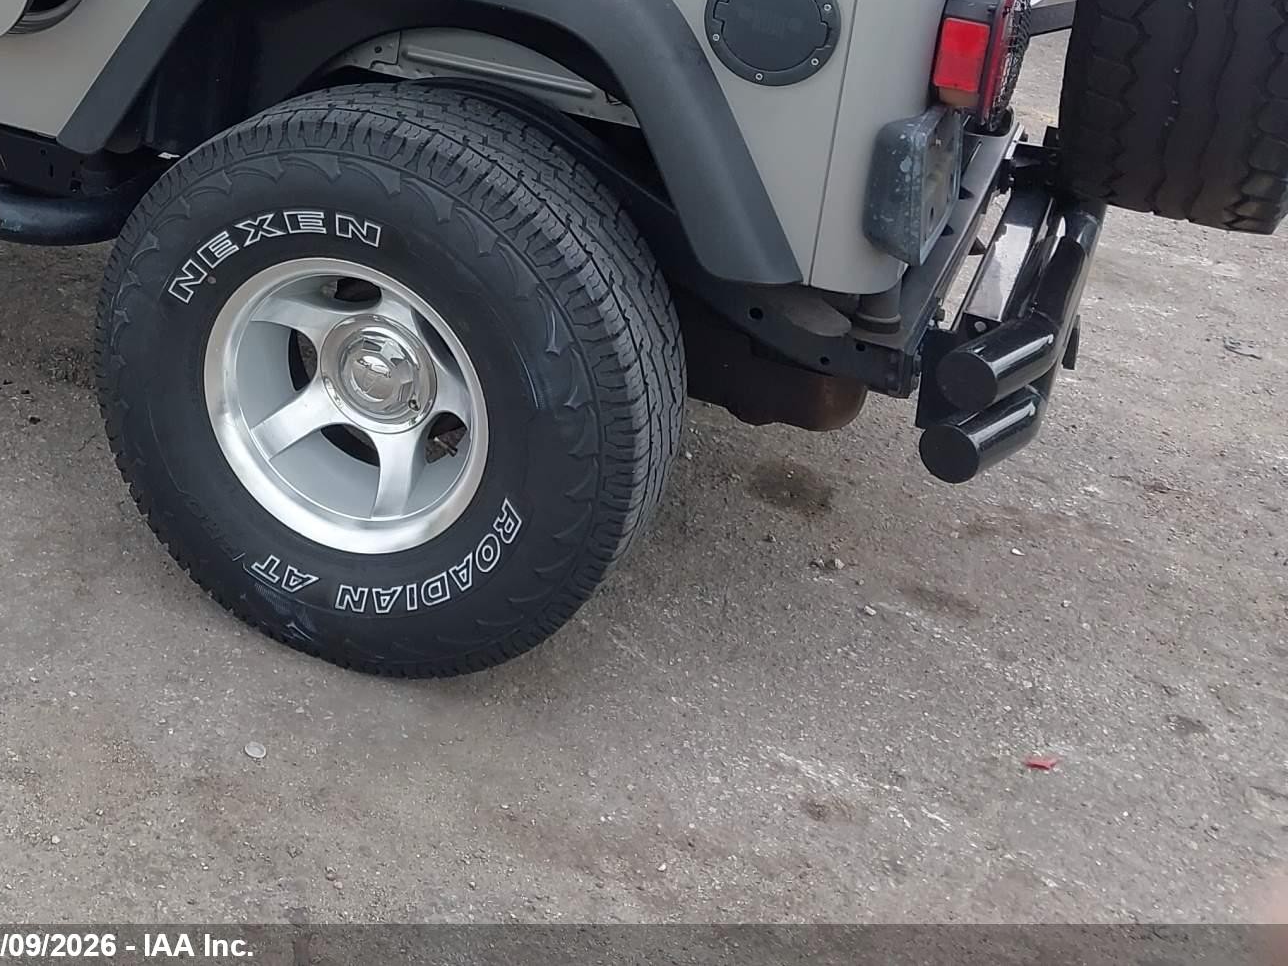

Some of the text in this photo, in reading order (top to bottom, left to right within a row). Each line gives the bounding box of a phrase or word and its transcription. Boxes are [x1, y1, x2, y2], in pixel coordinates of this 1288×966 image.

[167, 210, 383, 305] NEXEN
[251, 497, 524, 614] ROADIAN AT
